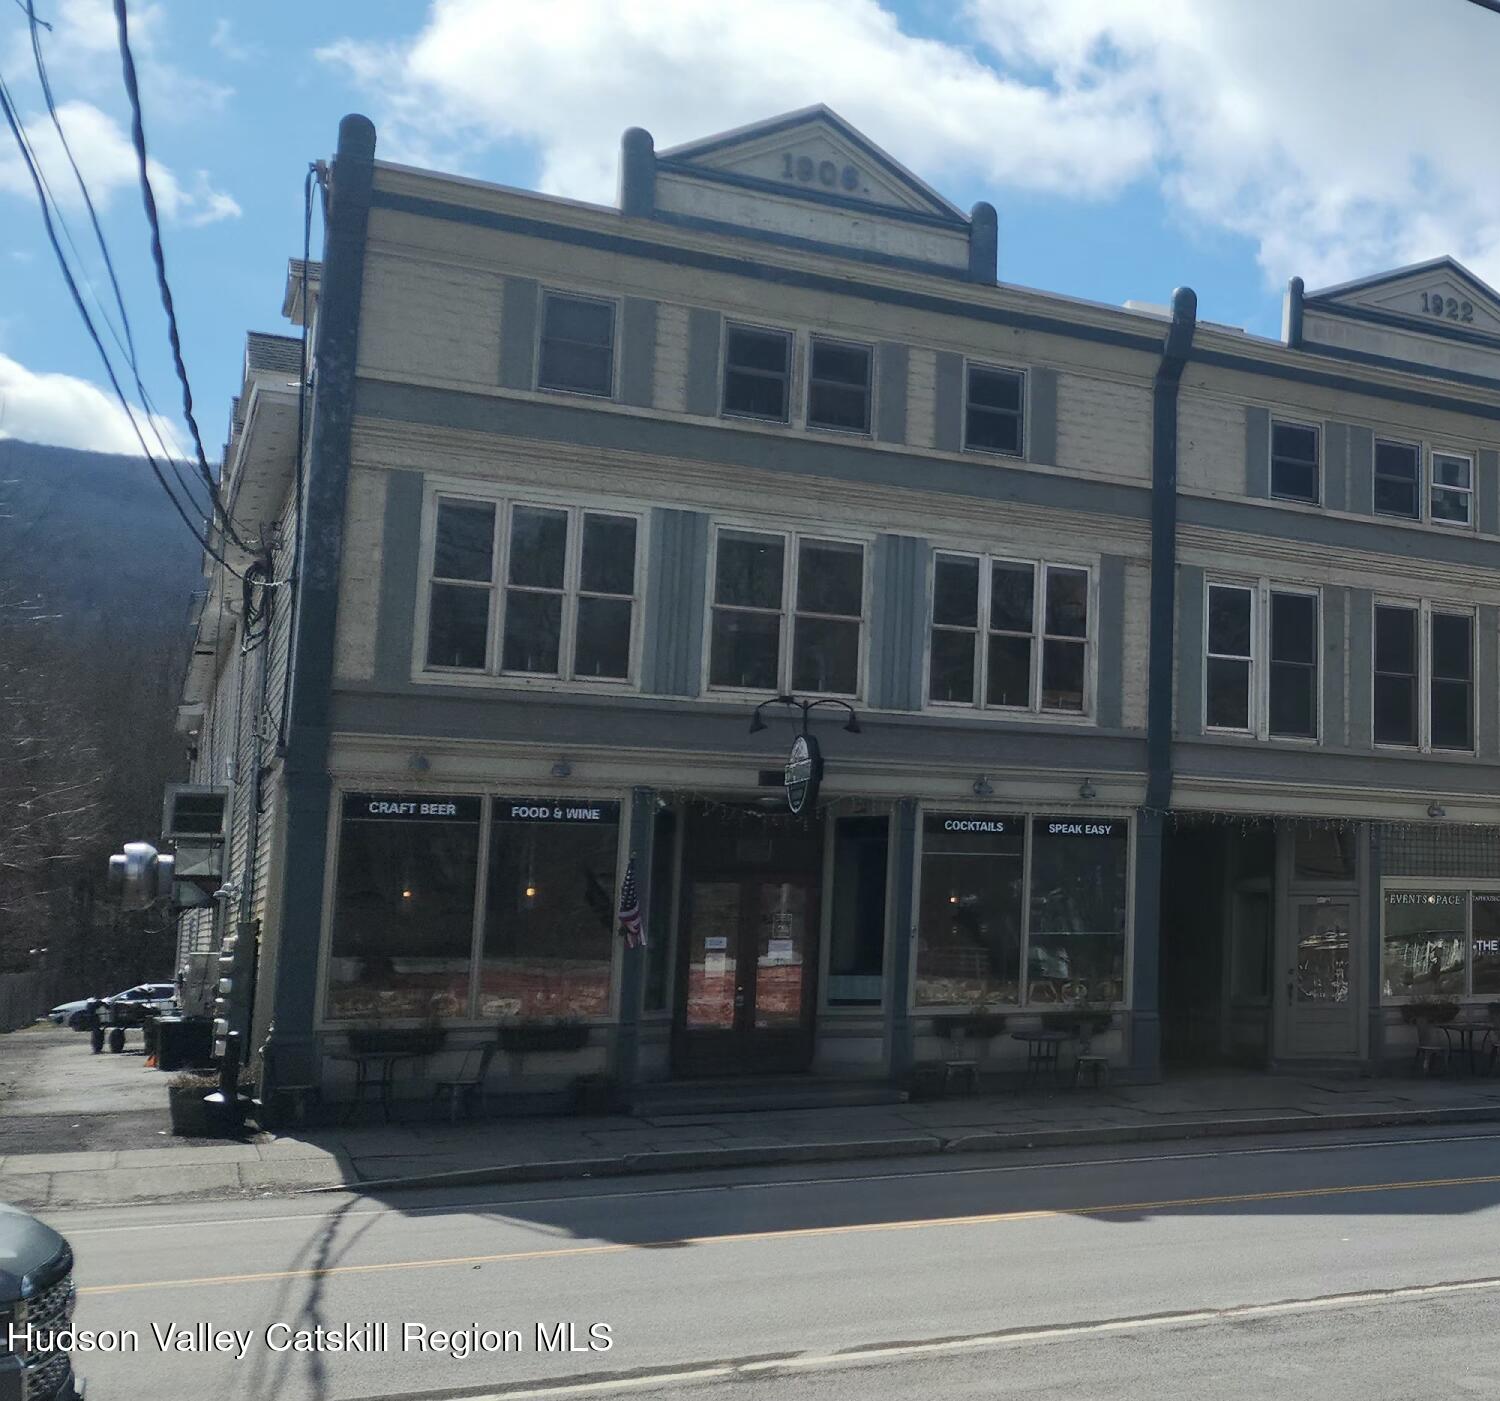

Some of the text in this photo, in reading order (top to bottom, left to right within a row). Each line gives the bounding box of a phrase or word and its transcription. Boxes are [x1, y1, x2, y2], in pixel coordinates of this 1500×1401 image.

[1421, 291, 1474, 323] 1922
[368, 801, 457, 816] CRAFT BEER
[511, 806, 600, 820] FOOD & WINE
[944, 820, 1004, 832] COCKTAILS
[1048, 823, 1112, 835] SPEAK EASY
[1390, 894, 1427, 905] EVENTS
[1476, 940, 1498, 951] THE
